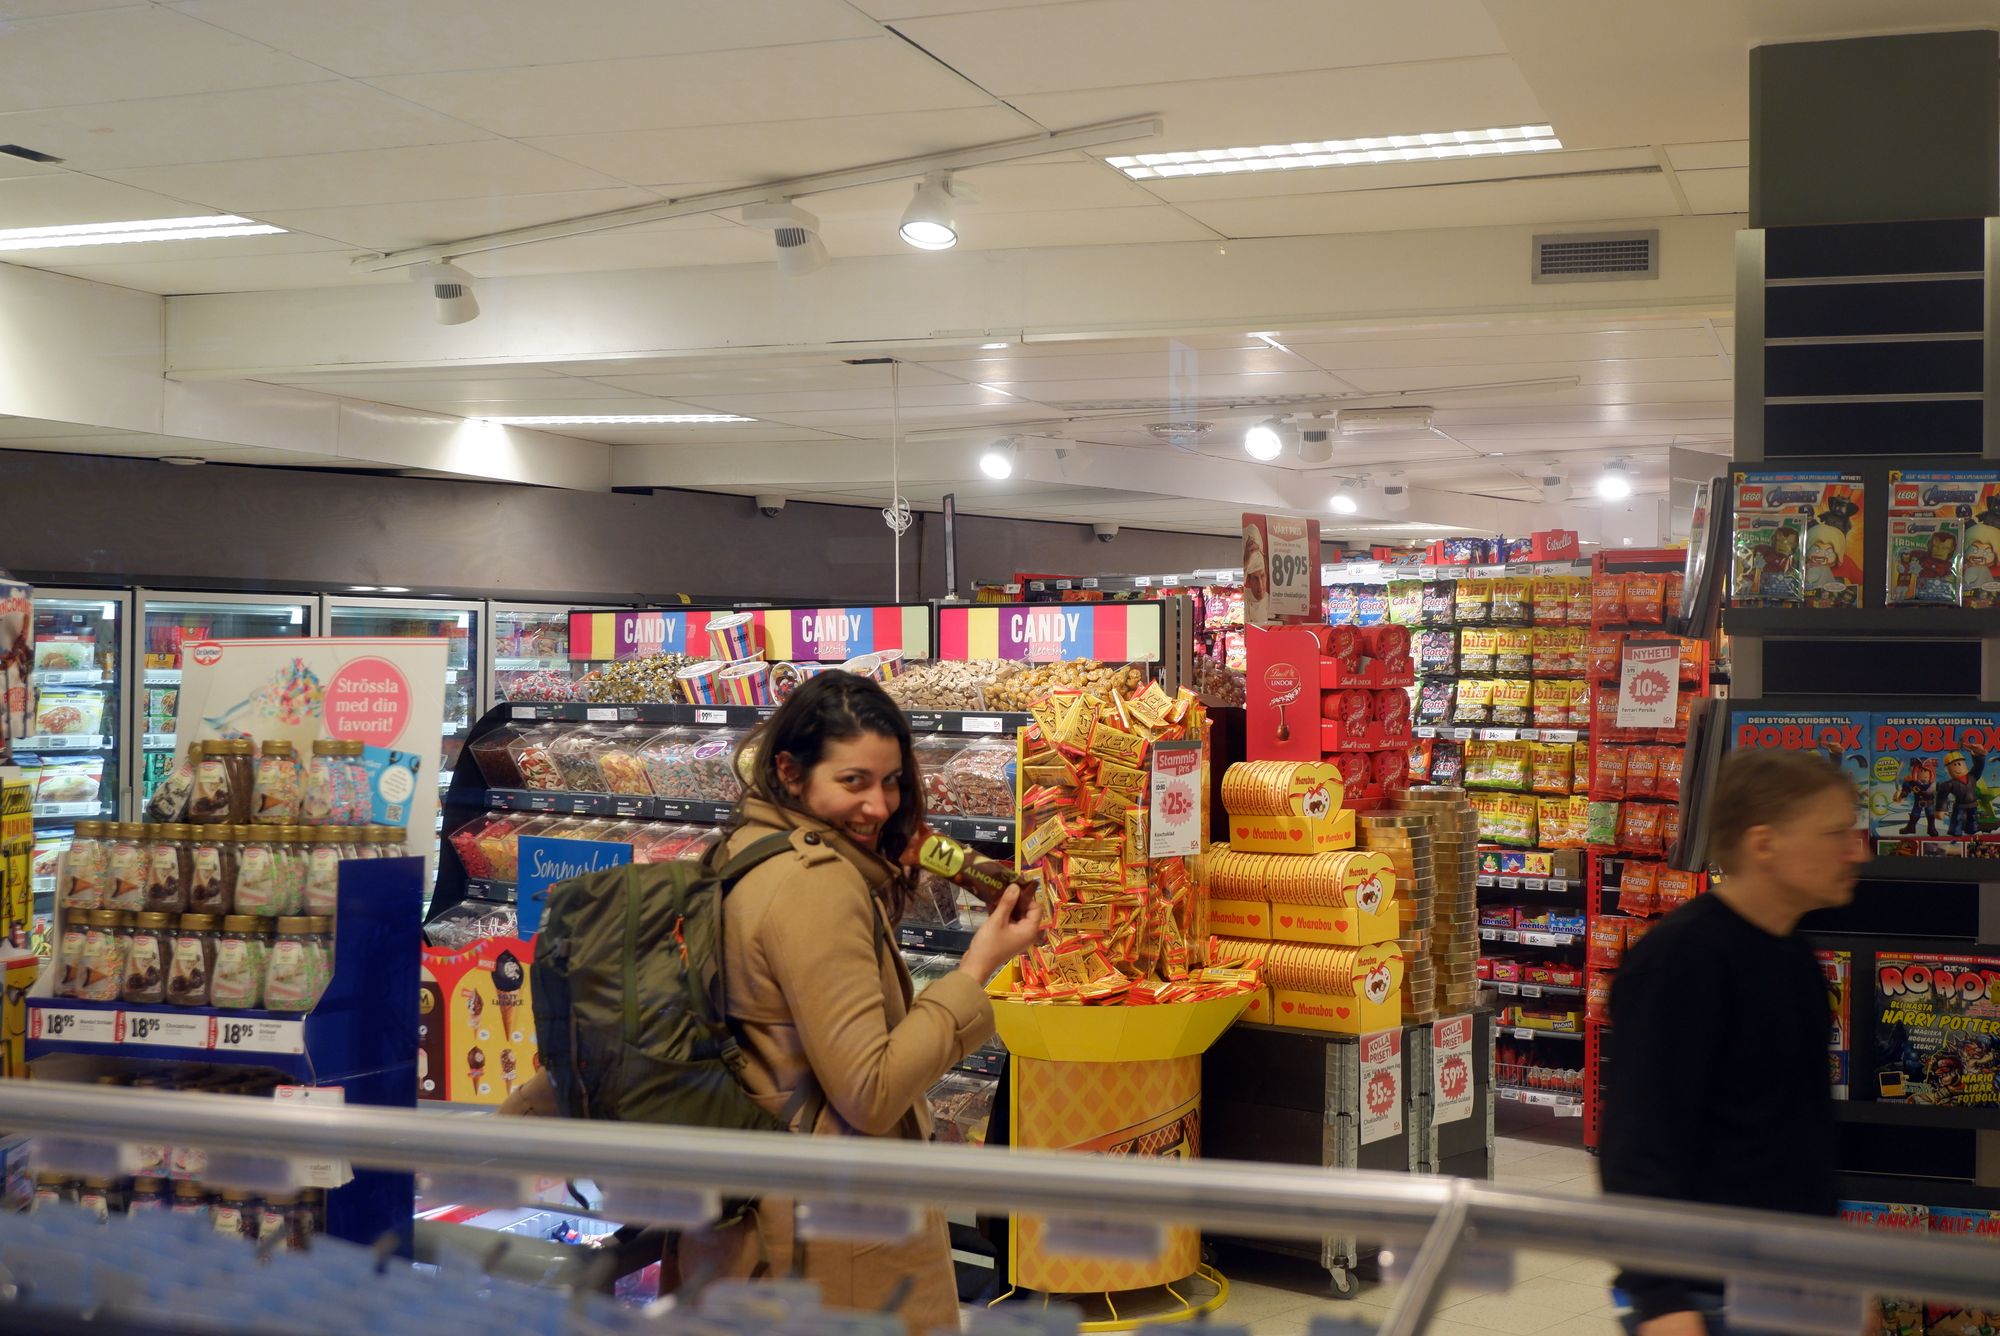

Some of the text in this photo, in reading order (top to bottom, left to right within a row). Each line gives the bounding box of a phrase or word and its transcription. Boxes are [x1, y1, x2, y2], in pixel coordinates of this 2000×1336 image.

[1742, 492, 1761, 501] LEGO
[1897, 491, 1917, 499] LEGO
[1546, 534, 1572, 551] Estrella
[1458, 583, 1487, 595] bilar
[1494, 582, 1521, 595] bilar
[1535, 582, 1561, 595] bilar
[1593, 588, 1619, 597] FERRARI
[1627, 587, 1657, 597] FERRARI
[624, 618, 676, 644] CANDY
[802, 614, 862, 644] CANDY
[1010, 612, 1080, 644] CANDY
[1462, 635, 1493, 647] bilar
[1499, 635, 1529, 647] bilar
[1534, 634, 1569, 647] bilar
[1588, 646, 1616, 654] FERRARI
[1633, 648, 1670, 660] NYHET!
[336, 677, 399, 694] Strössla
[1634, 678, 1664, 697] 10:-
[1459, 686, 1488, 699] bilar
[1494, 686, 1526, 699] bilar
[1535, 686, 1568, 699] bilar
[336, 697, 398, 713] med din
[338, 716, 393, 734] favorit!
[1748, 716, 1766, 724] DEN
[1887, 717, 1904, 725] DEN
[1096, 734, 1137, 753] KEX
[1737, 724, 1863, 750] ROBLOX
[1876, 725, 2000, 752] ROBLOX
[1160, 751, 1196, 766] Stammis
[1465, 746, 1489, 758] bila
[1495, 746, 1526, 759] bilar
[1534, 750, 1565, 764] bilar
[1628, 761, 1654, 770] FERRARI
[1103, 772, 1142, 788] KEX
[1295, 775, 1316, 786] Marabou
[1168, 791, 1192, 815] 25:-
[1469, 799, 1496, 812] bilar
[1501, 800, 1534, 814] bilar
[1540, 805, 1568, 819] bila
[1626, 817, 1653, 828] FERRARI
[1252, 826, 1287, 840] Marabou
[1325, 833, 1344, 842] Marabou
[964, 866, 1004, 890] ALMOND
[1348, 867, 1368, 878] Marabou
[1621, 875, 1650, 887] FERRARI
[1658, 880, 1688, 889] FERRARI
[1211, 910, 1245, 924] Marabou
[1296, 916, 1332, 931] Marabou
[1483, 918, 1510, 926] mentos
[1520, 922, 1549, 931] mentos
[1591, 932, 1619, 941] FERRARI
[1297, 1003, 1334, 1018] Marabou
[1882, 1010, 2000, 1035] HARRY POTTER
[1441, 1023, 1462, 1039] KOLLA
[1369, 1035, 1390, 1052] KOLLA
[1441, 1035, 1462, 1049] PRISET!
[1908, 1036, 1942, 1044] HOGWARTS
[1369, 1047, 1391, 1063] PRISET!
[1961, 1073, 1994, 1083] MARIO
[1371, 1081, 1392, 1106] 35:-
[1964, 1083, 1992, 1093] LIRAR
